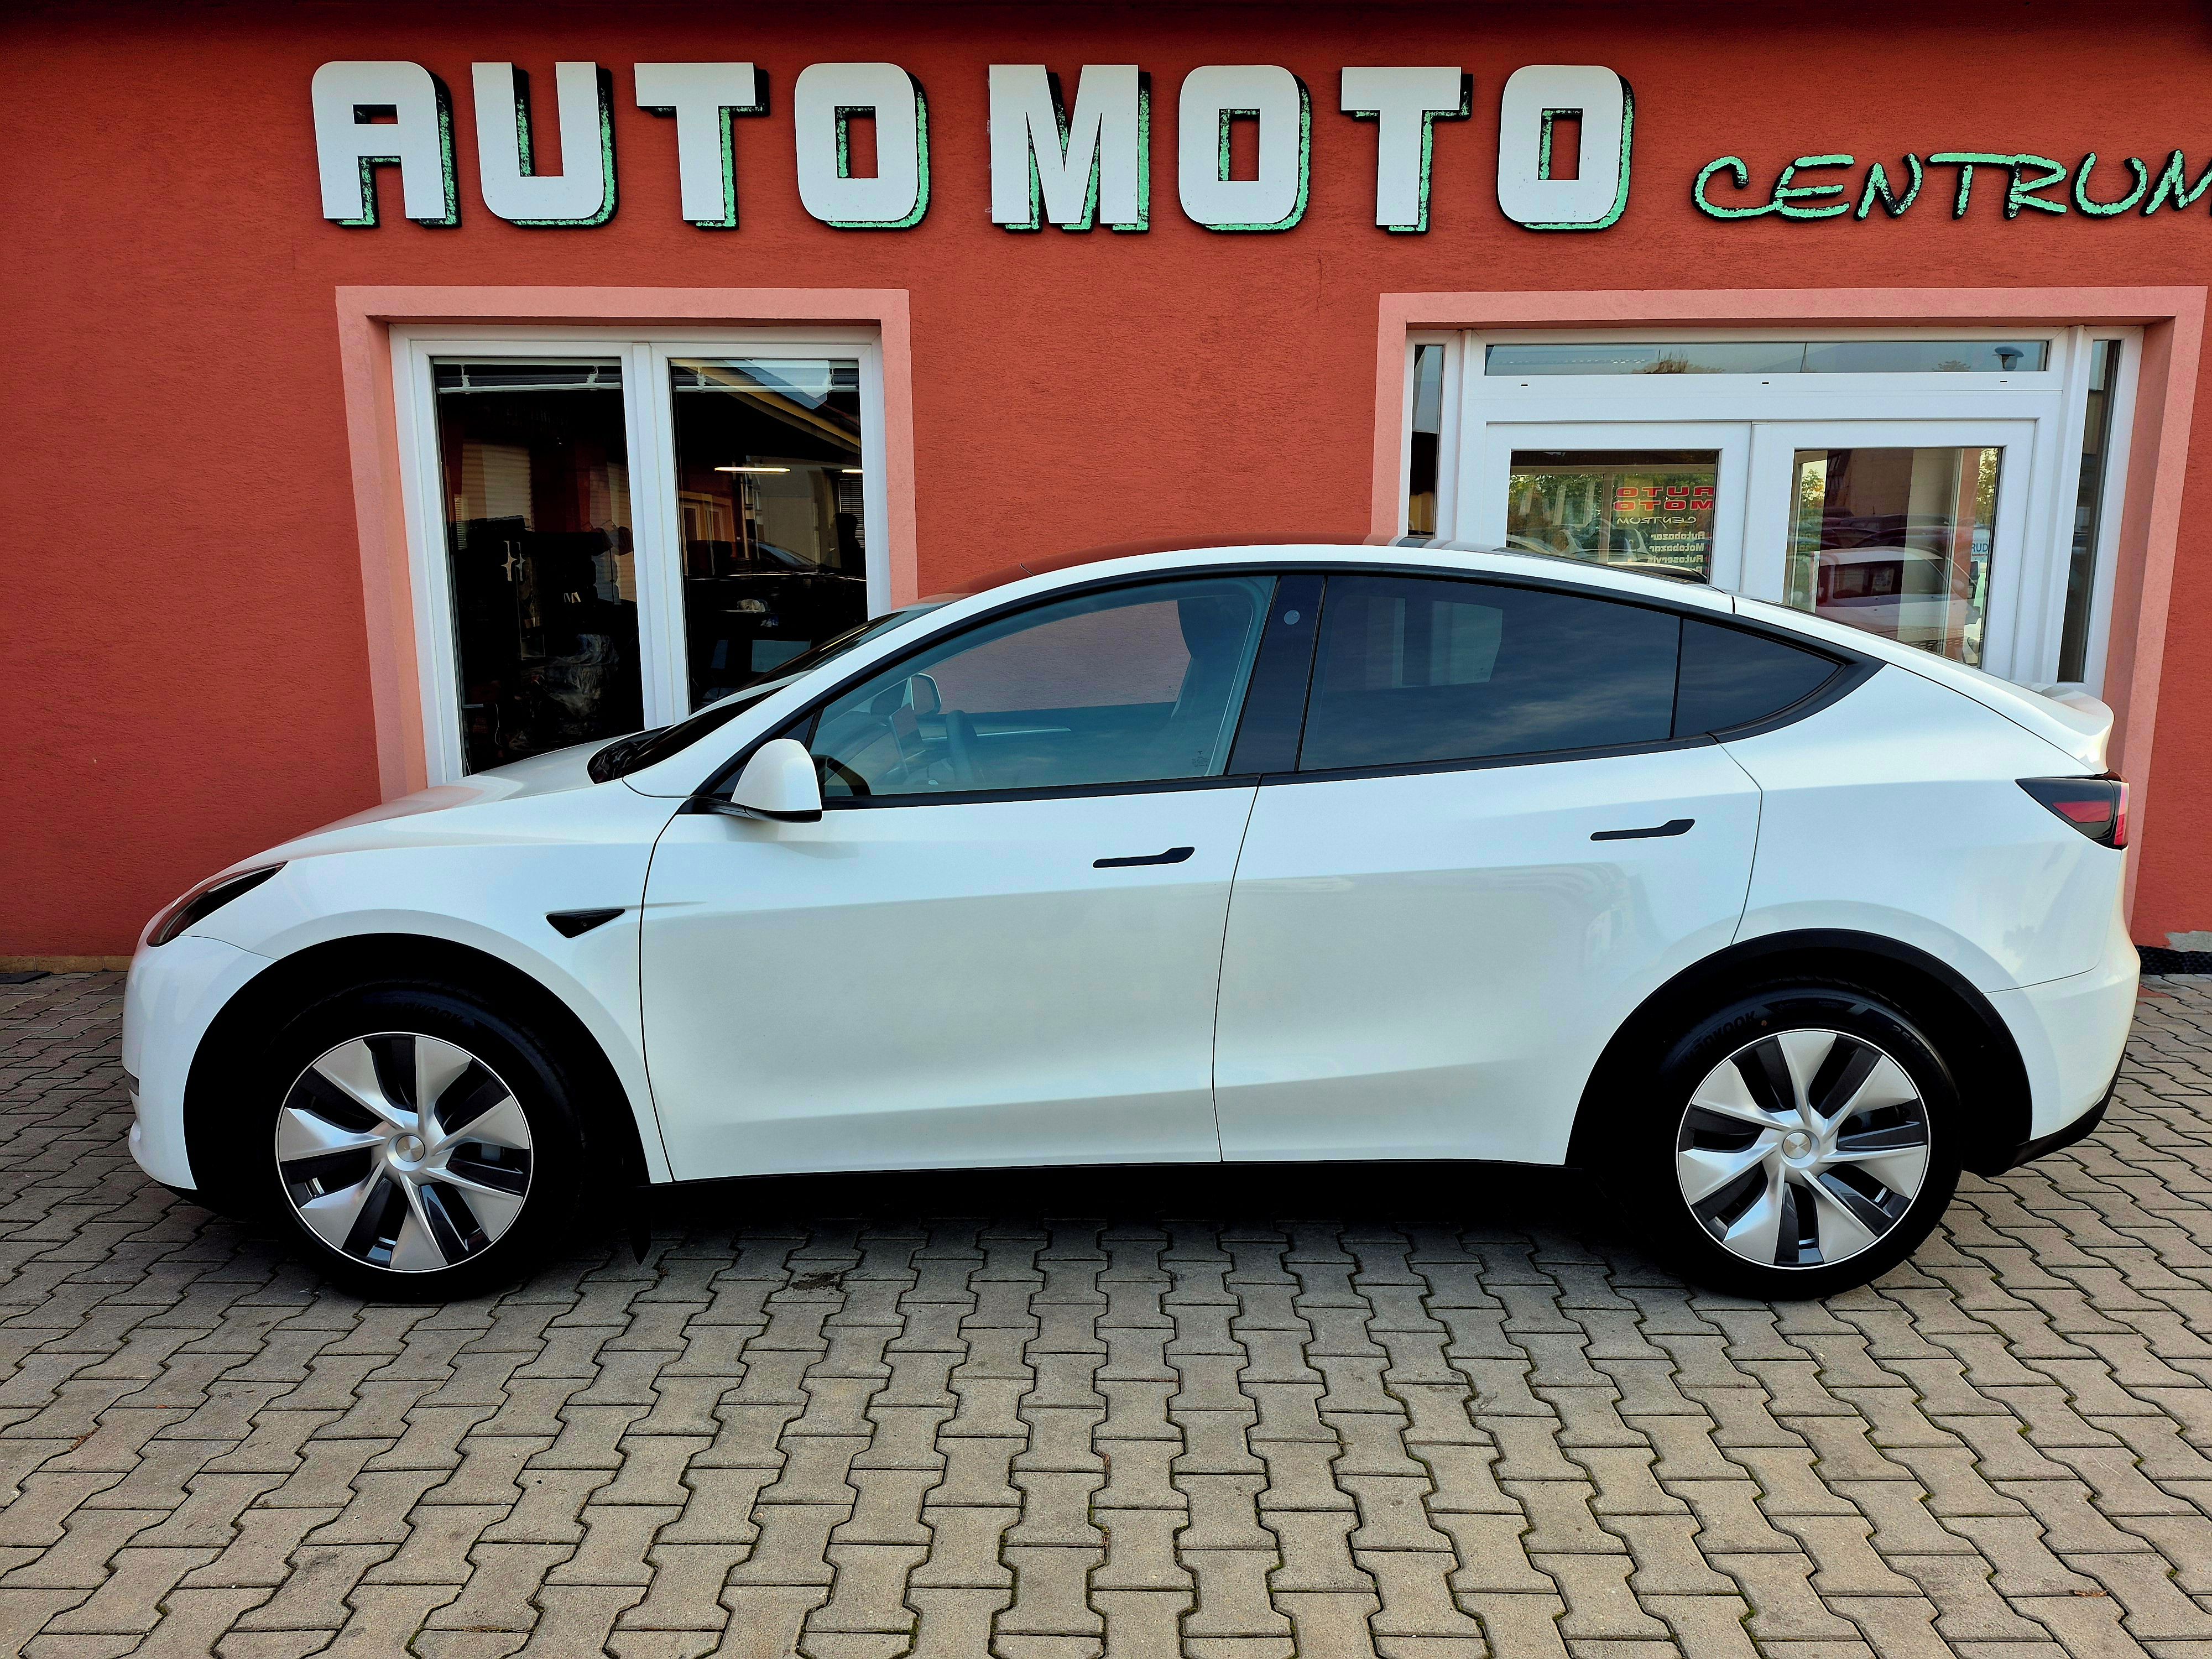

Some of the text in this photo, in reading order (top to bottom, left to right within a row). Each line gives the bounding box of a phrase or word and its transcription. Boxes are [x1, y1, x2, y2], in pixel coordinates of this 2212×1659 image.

[311, 61, 1634, 233] AUTO MOTO
[1691, 149, 2212, 221] CENTRUM
